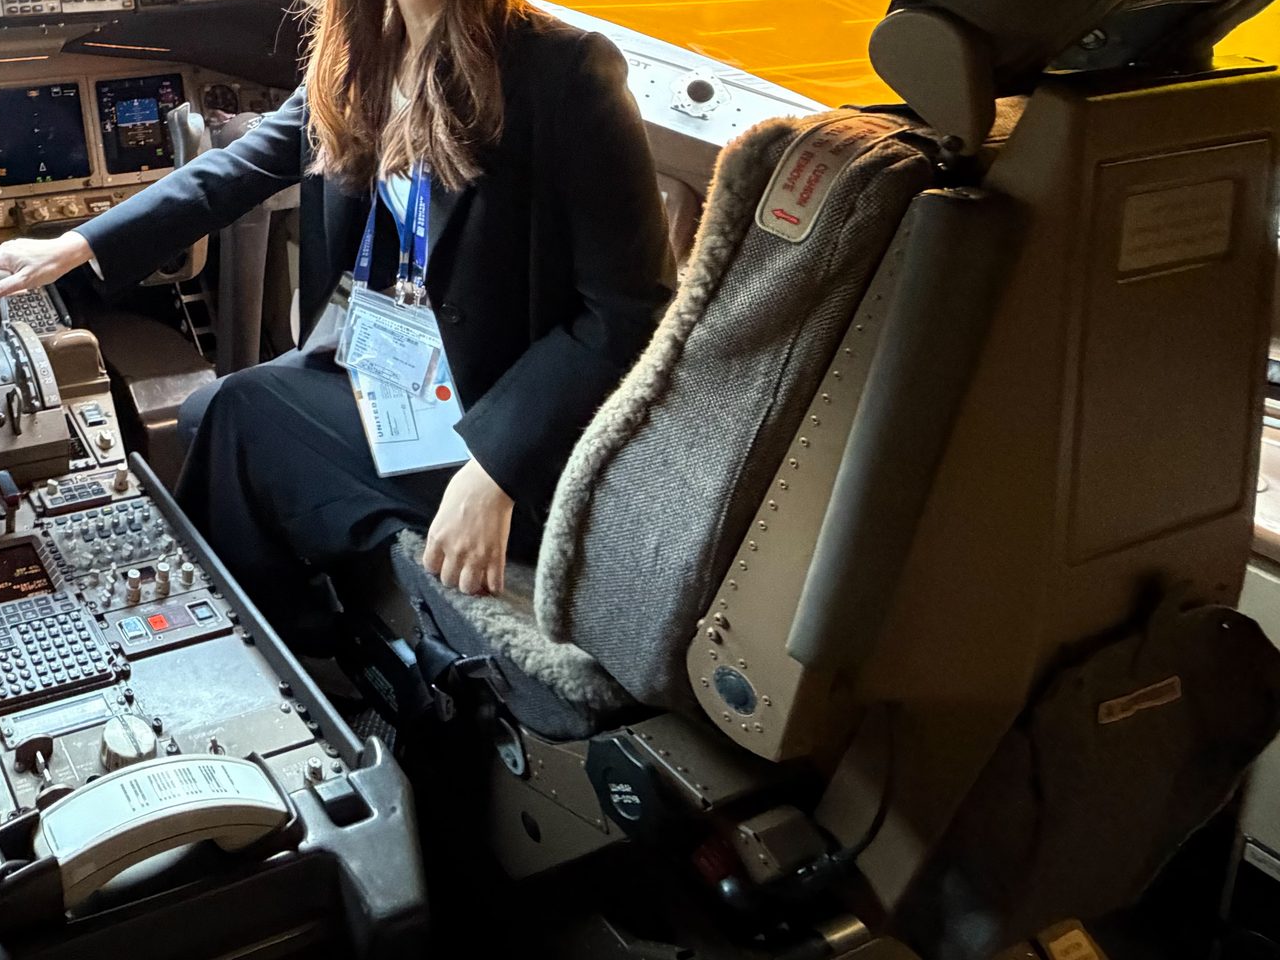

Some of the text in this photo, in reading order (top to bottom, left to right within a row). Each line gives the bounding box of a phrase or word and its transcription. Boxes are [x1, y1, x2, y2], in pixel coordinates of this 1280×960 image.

[783, 150, 815, 192] REMOVE
[796, 163, 830, 207] CUSHION
[371, 401, 384, 438] UNITED
